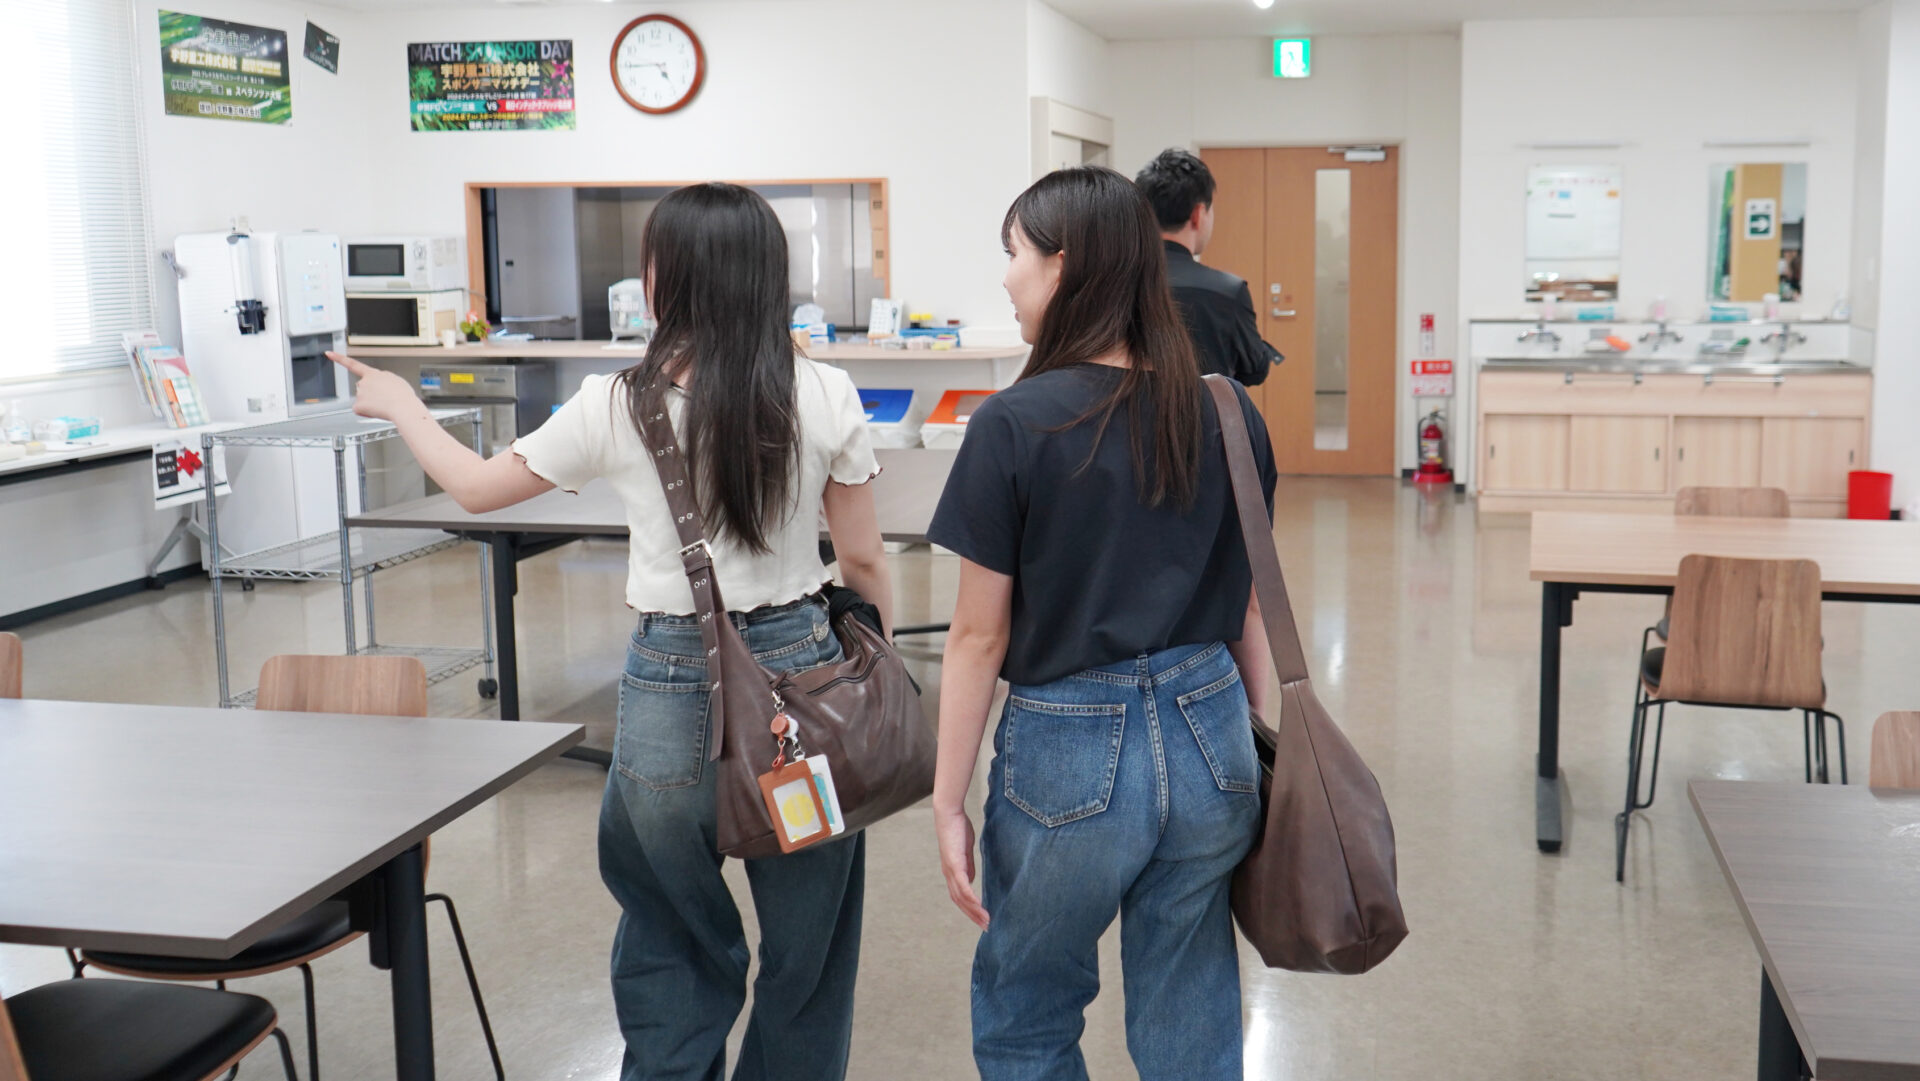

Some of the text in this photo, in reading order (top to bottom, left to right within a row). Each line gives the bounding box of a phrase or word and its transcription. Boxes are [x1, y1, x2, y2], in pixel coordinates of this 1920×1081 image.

[411, 41, 569, 61] MATCH SPONSOR DAY
[442, 77, 540, 90] スポンサーマッチデー
[486, 101, 498, 111] VS
